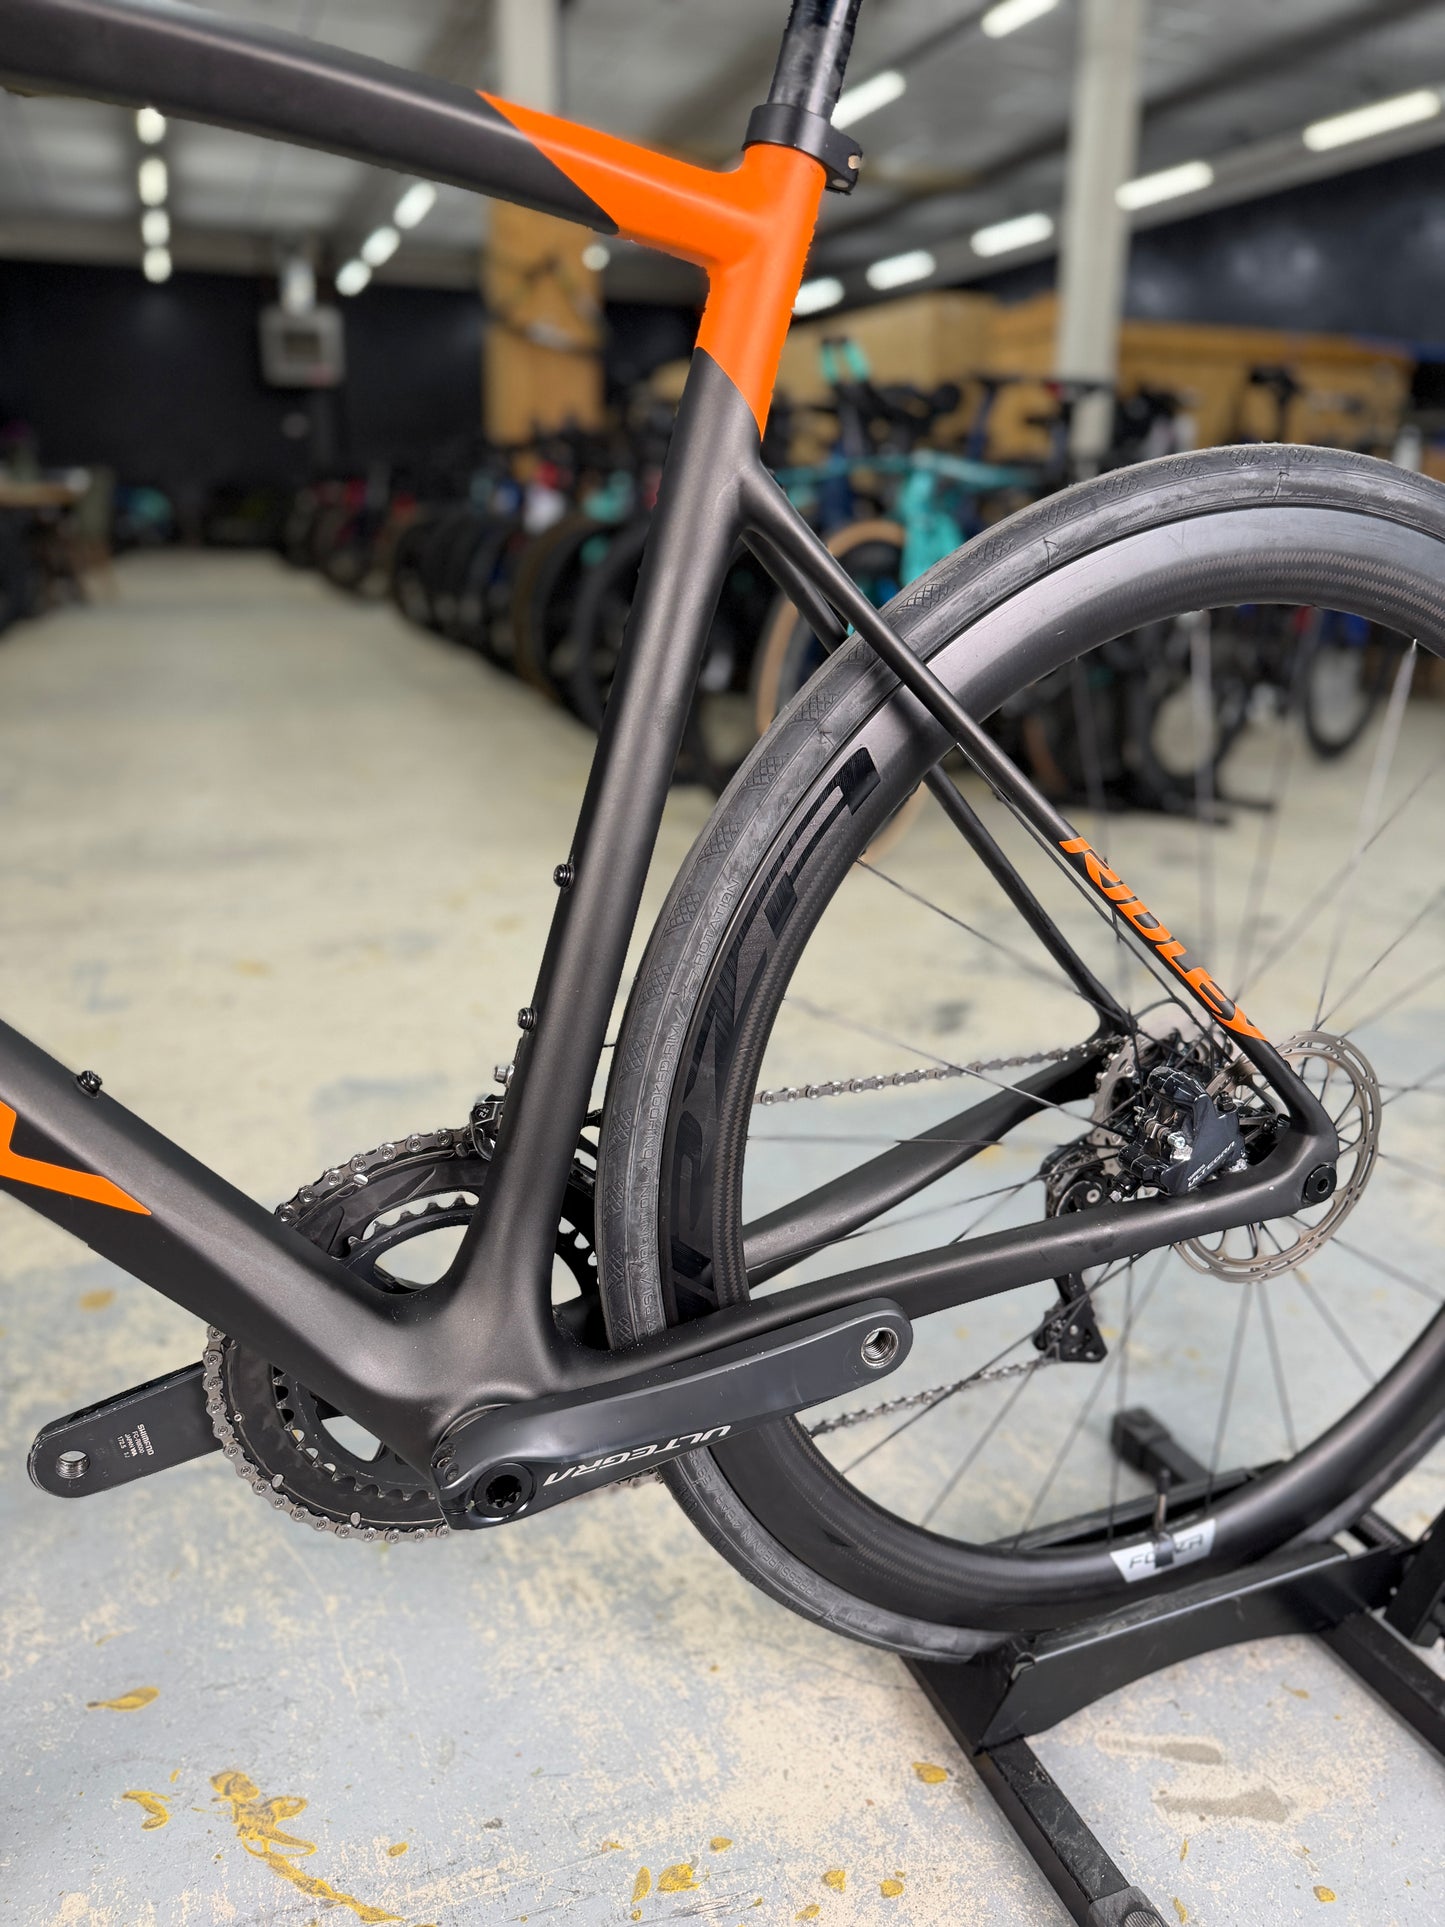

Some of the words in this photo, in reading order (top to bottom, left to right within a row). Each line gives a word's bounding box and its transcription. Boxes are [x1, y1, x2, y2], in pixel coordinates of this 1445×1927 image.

[647, 1059, 671, 1133] HOOKED
[663, 1023, 681, 1056] RIM
[693, 879, 741, 966] ROTATION
[1058, 836, 1270, 1042] RIDLEY
[542, 1424, 732, 1488] ULTEGRA
[1128, 1531, 1205, 1569] FOZA
